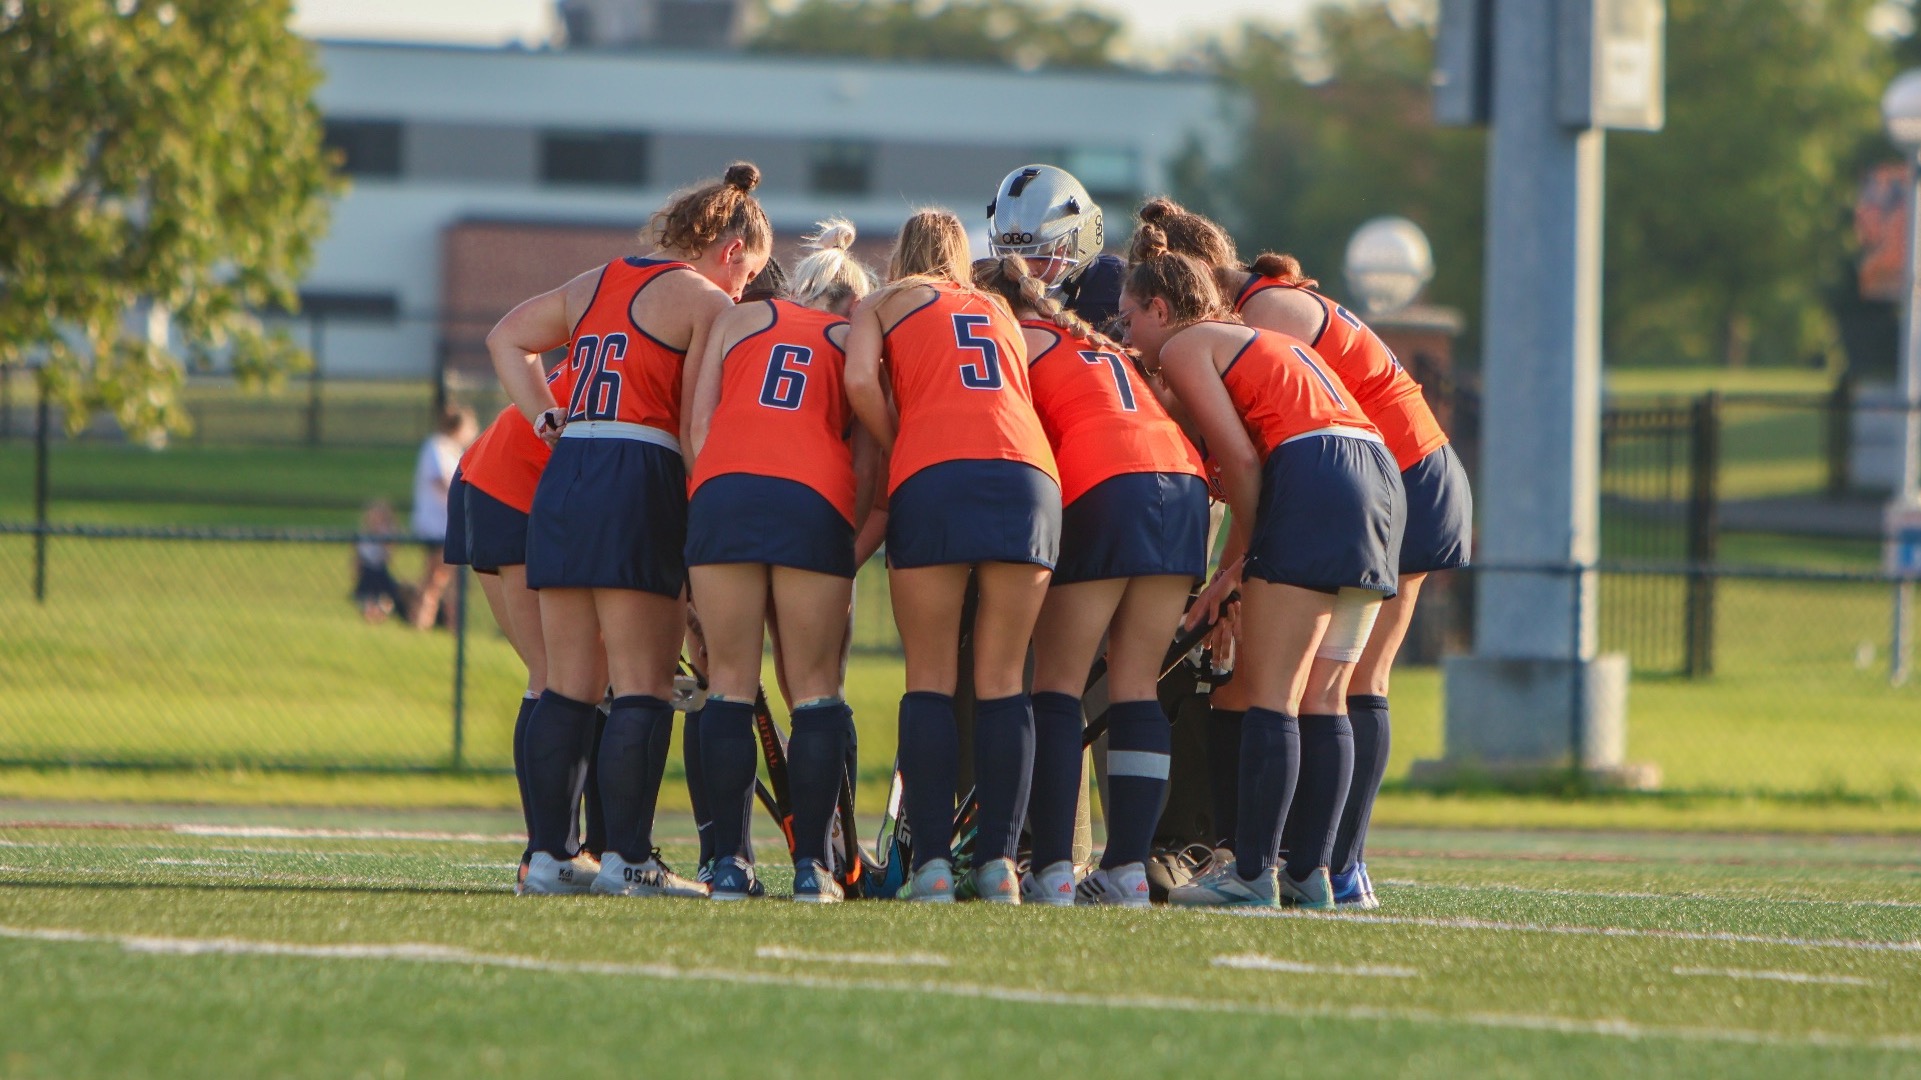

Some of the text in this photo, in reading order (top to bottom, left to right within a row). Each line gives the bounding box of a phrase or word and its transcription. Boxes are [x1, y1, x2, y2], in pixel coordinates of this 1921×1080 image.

[1002, 233, 1033, 244] OBO
[567, 332, 628, 421] 26
[758, 343, 813, 410] 6
[951, 313, 1004, 390] 5
[1078, 350, 1138, 412] 7
[1290, 345, 1348, 411] 1
